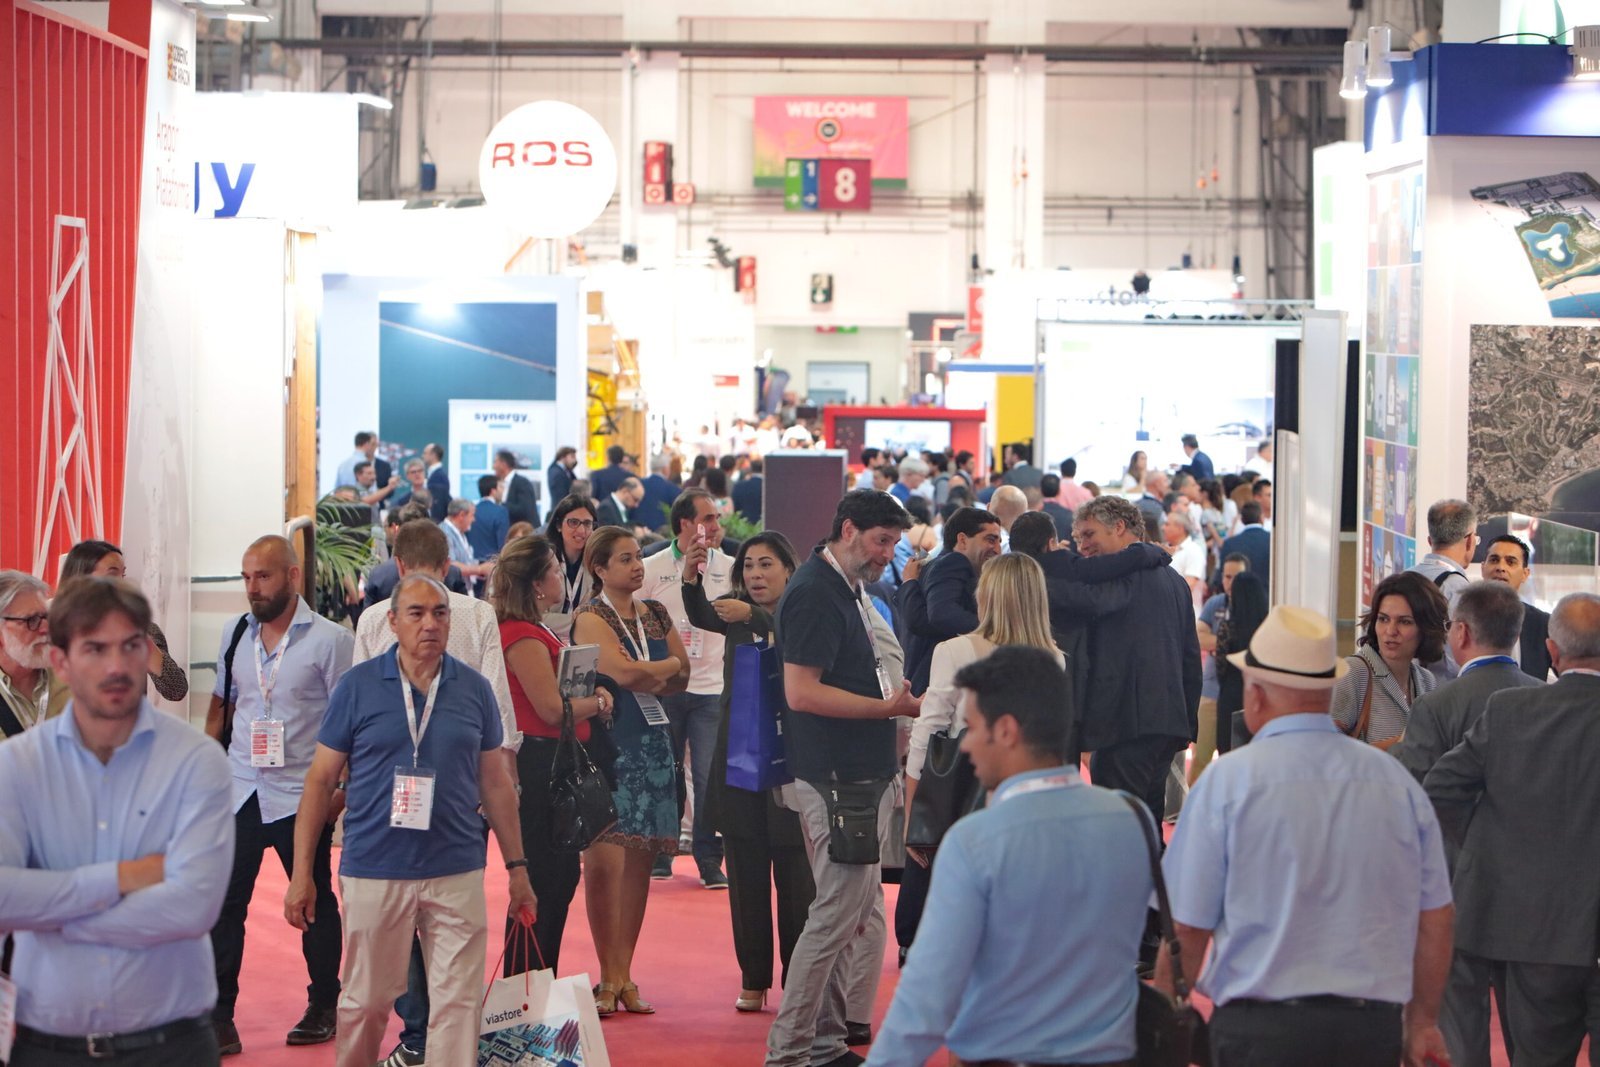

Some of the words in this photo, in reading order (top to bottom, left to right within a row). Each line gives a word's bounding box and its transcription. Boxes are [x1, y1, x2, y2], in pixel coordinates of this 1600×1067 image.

[784, 101, 877, 119] WELCOME
[492, 141, 593, 168] ROS
[834, 167, 856, 202] 8
[485, 1008, 522, 1025] viastore
